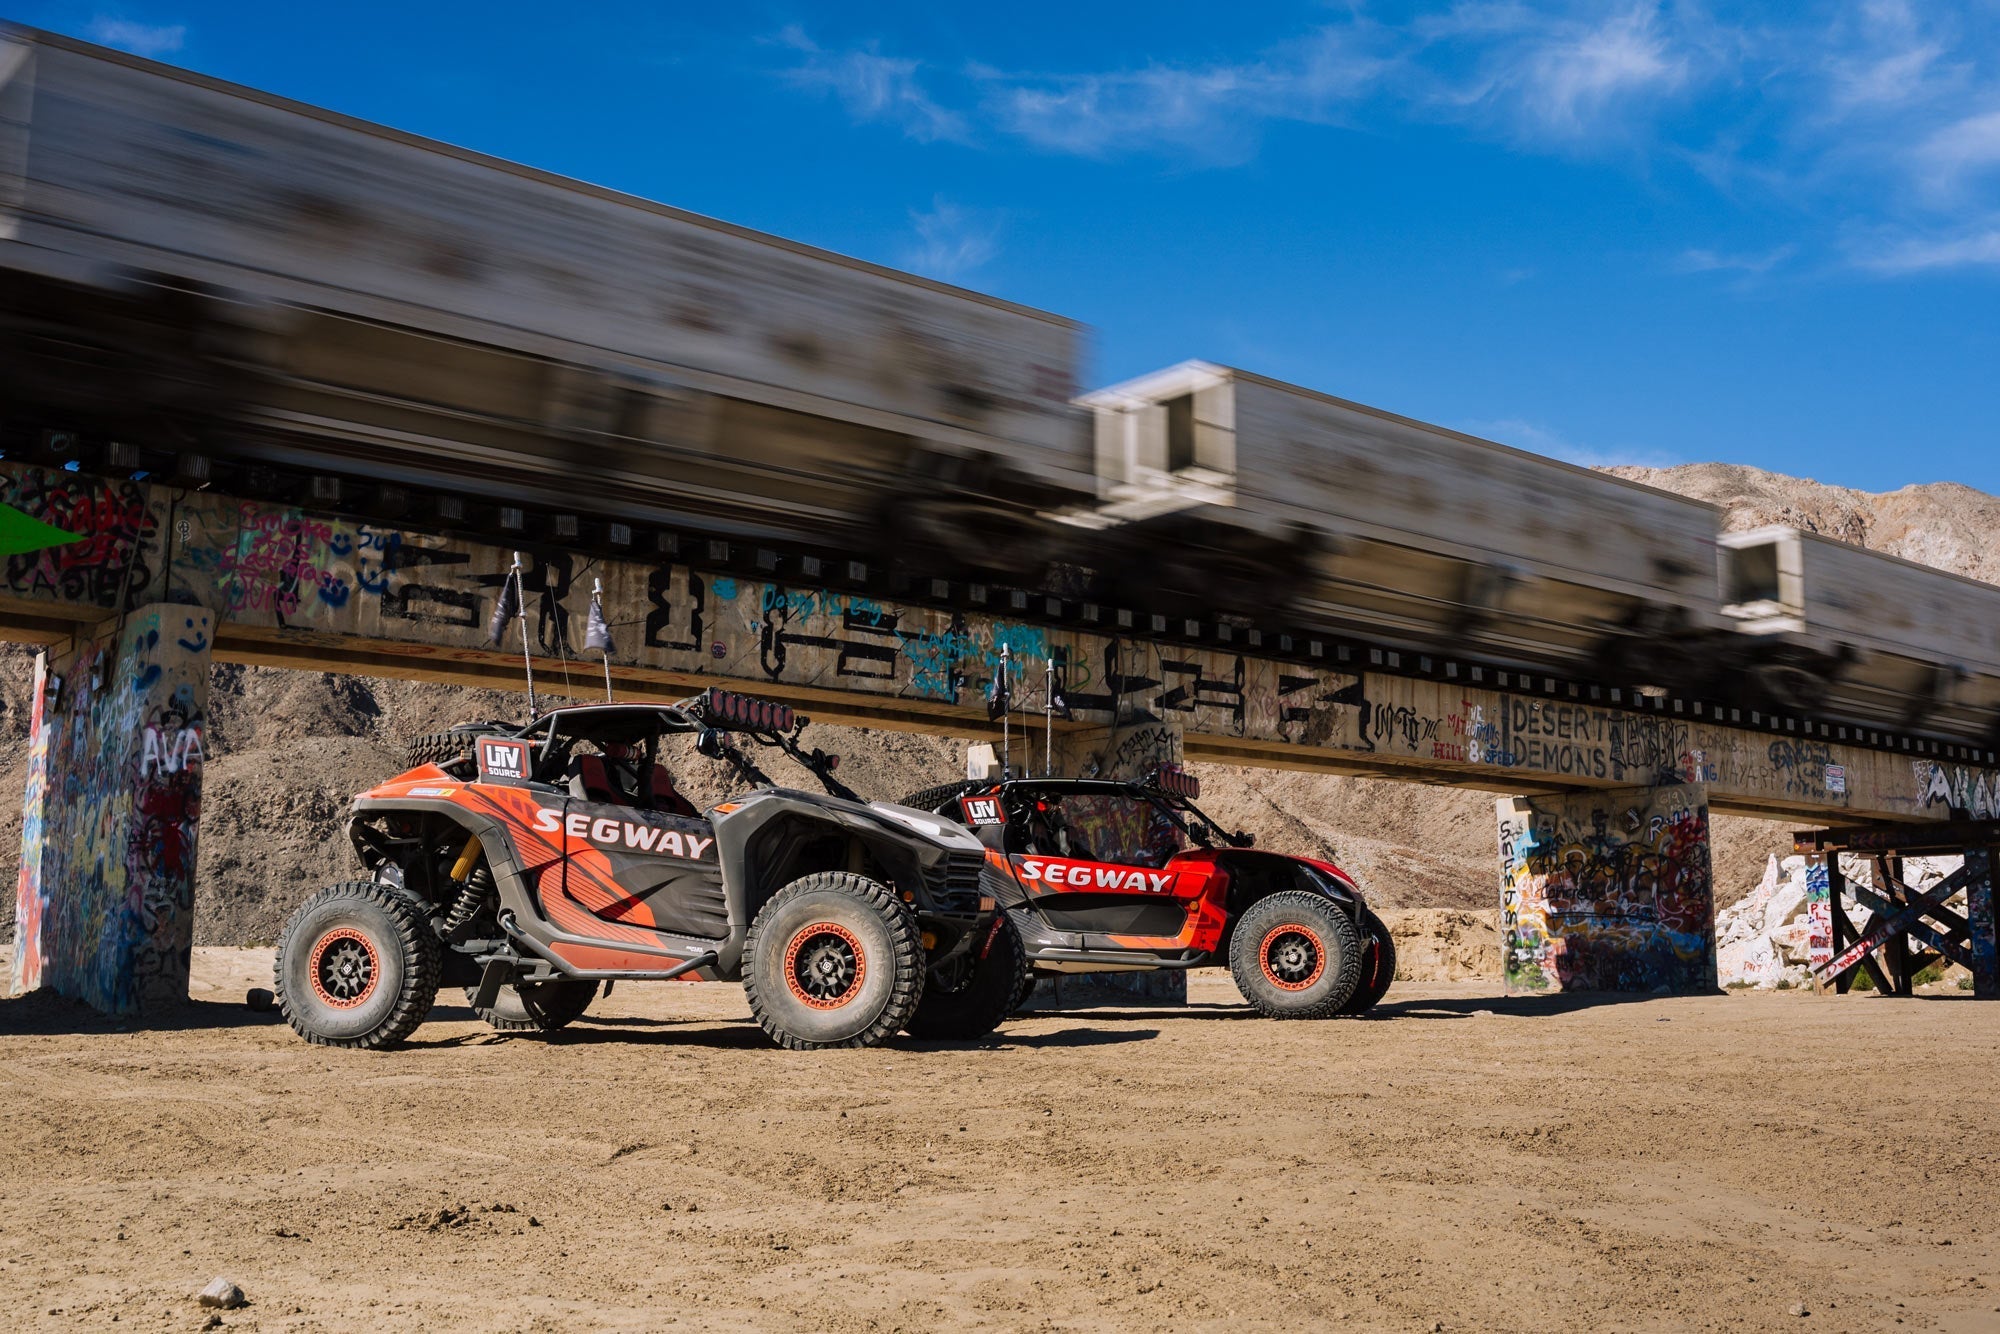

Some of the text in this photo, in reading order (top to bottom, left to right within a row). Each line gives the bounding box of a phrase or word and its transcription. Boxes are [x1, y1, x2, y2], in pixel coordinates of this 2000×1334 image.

[1513, 700, 1608, 743] DESERT
[141, 727, 204, 778] AVA
[486, 744, 519, 769] UTV
[1513, 735, 1607, 779] DEMONS
[488, 767, 521, 779] SOURCE
[1686, 763, 1717, 783] GANG
[967, 799, 996, 818] UTV
[973, 817, 1001, 825] SOURCE
[532, 808, 714, 860] SEGWAY
[1021, 860, 1172, 893] SEGWAY
